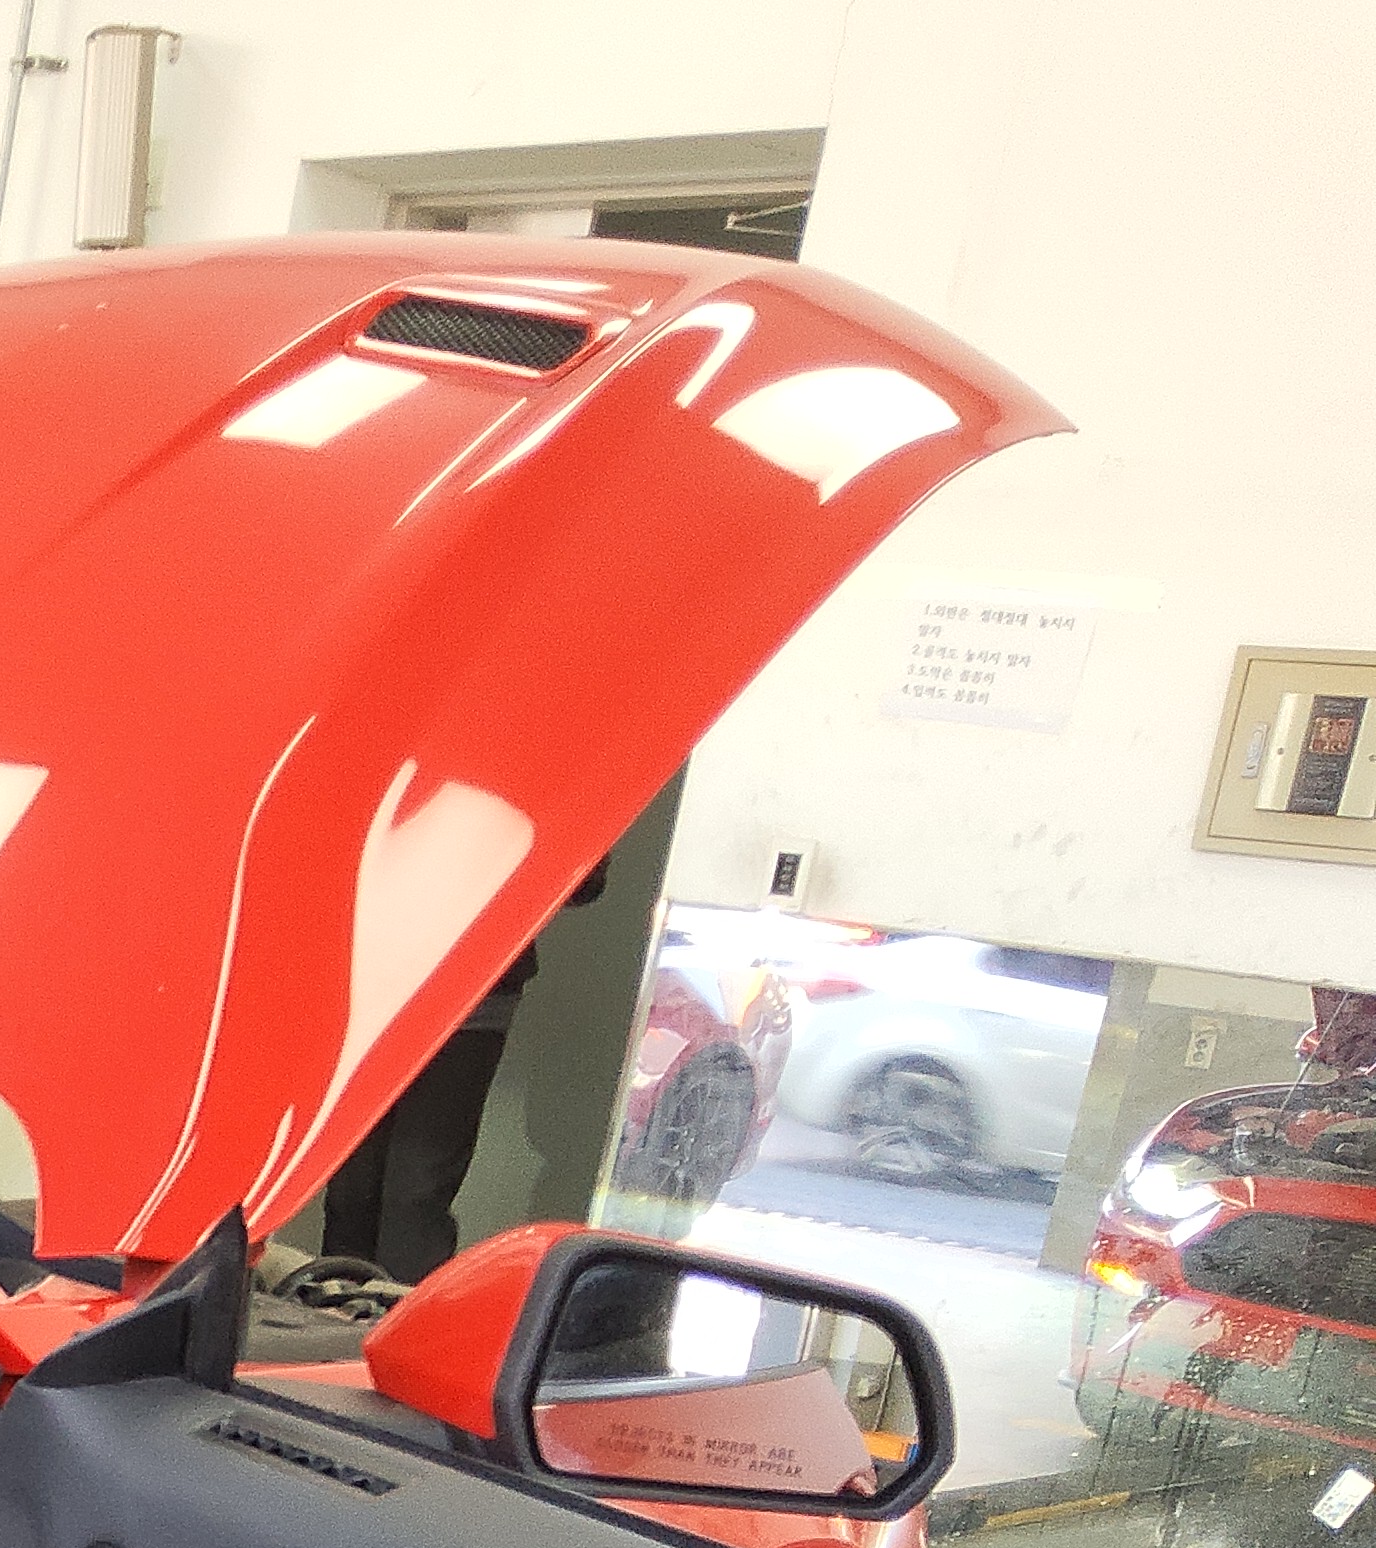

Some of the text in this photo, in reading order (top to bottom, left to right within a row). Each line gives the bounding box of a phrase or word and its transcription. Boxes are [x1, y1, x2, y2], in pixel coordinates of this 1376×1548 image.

[705, 1439, 757, 1456] MIRROR
[767, 1447, 797, 1462] ARE
[748, 1461, 803, 1478] APPEAR
